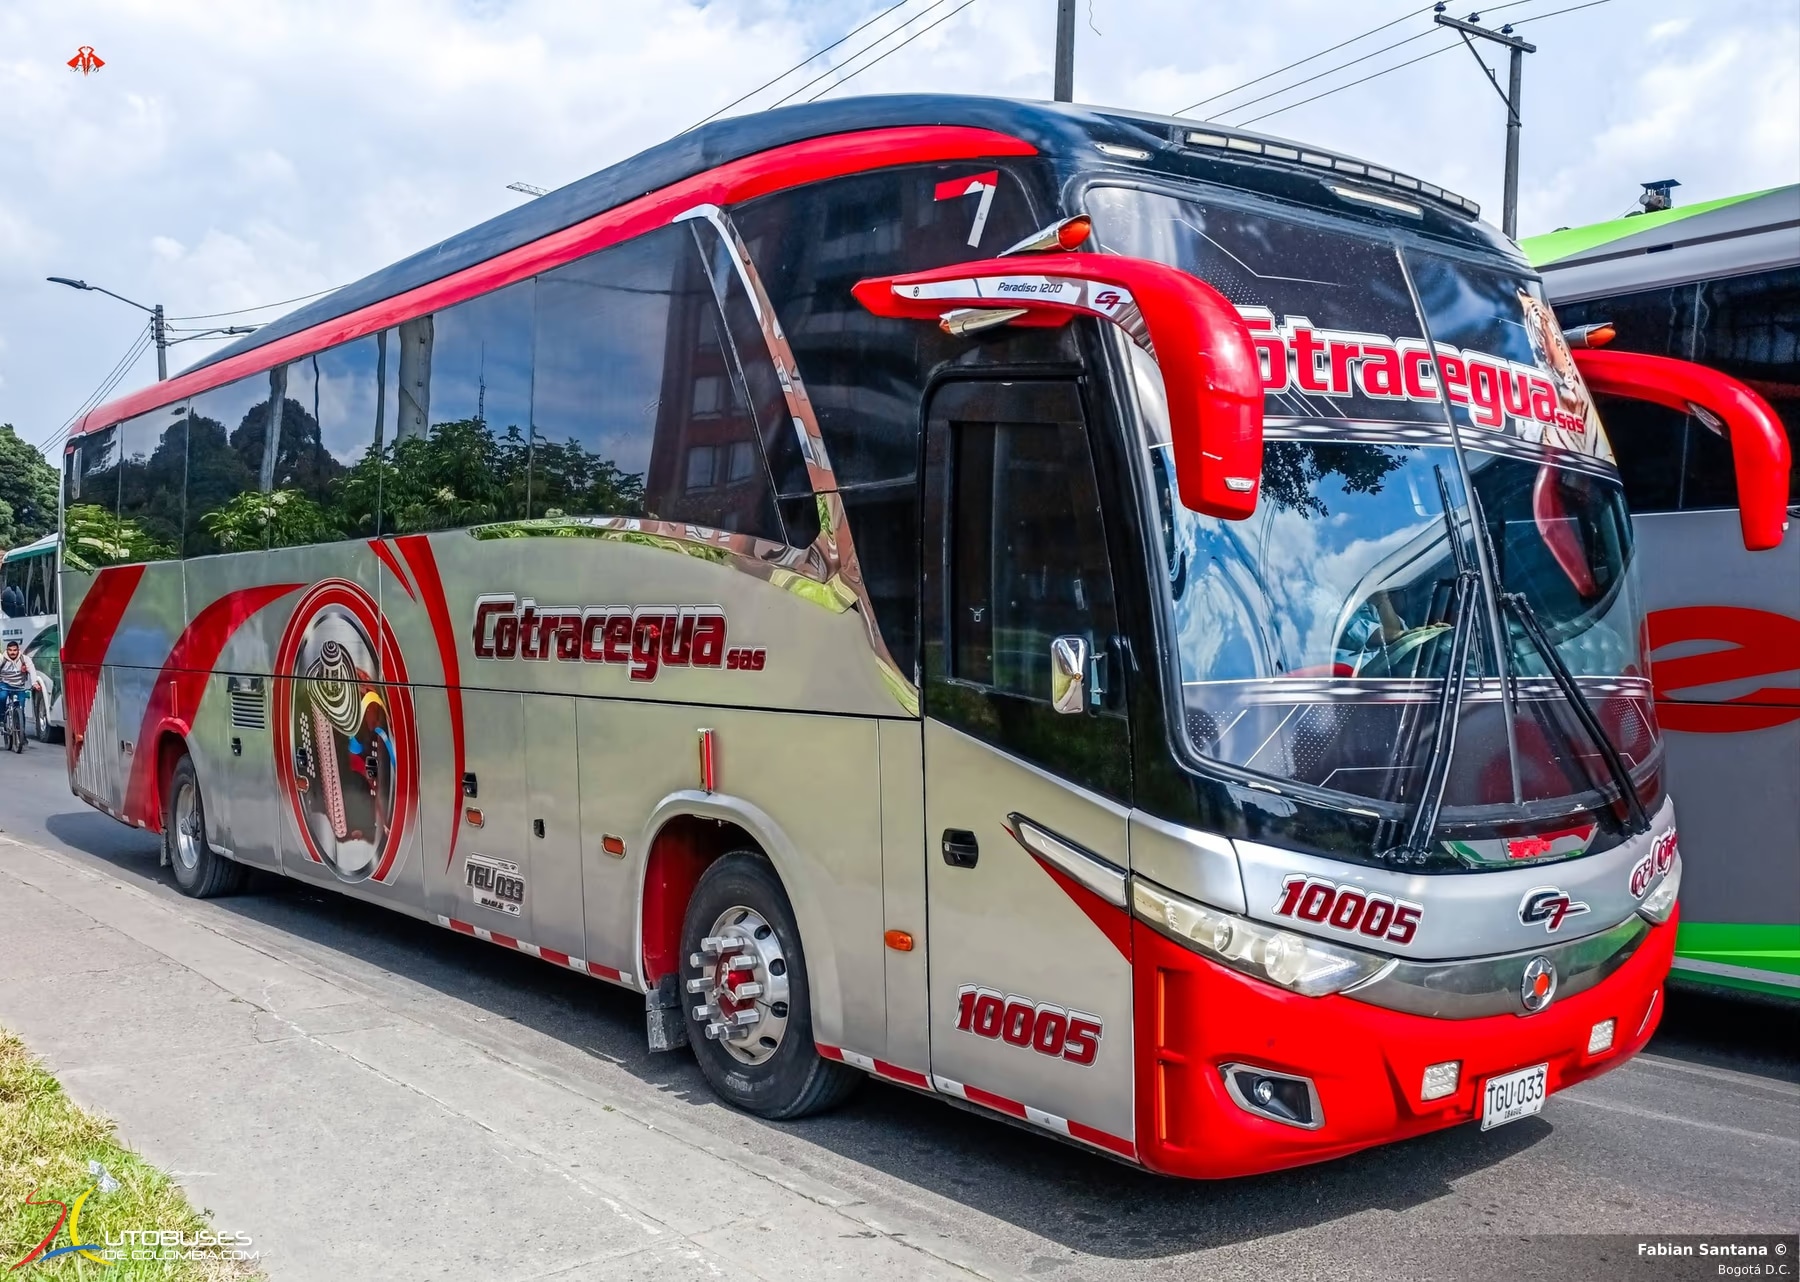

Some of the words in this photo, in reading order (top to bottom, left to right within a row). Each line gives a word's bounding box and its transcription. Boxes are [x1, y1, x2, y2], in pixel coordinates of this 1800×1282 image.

[998, 282, 1037, 293] Paradiso
[1039, 283, 1063, 294] 1200
[472, 592, 728, 683] Cotracegua
[466, 861, 497, 892] TGU
[495, 875, 524, 905] 033
[1272, 873, 1424, 946] 10005
[953, 984, 1104, 1068] 10005
